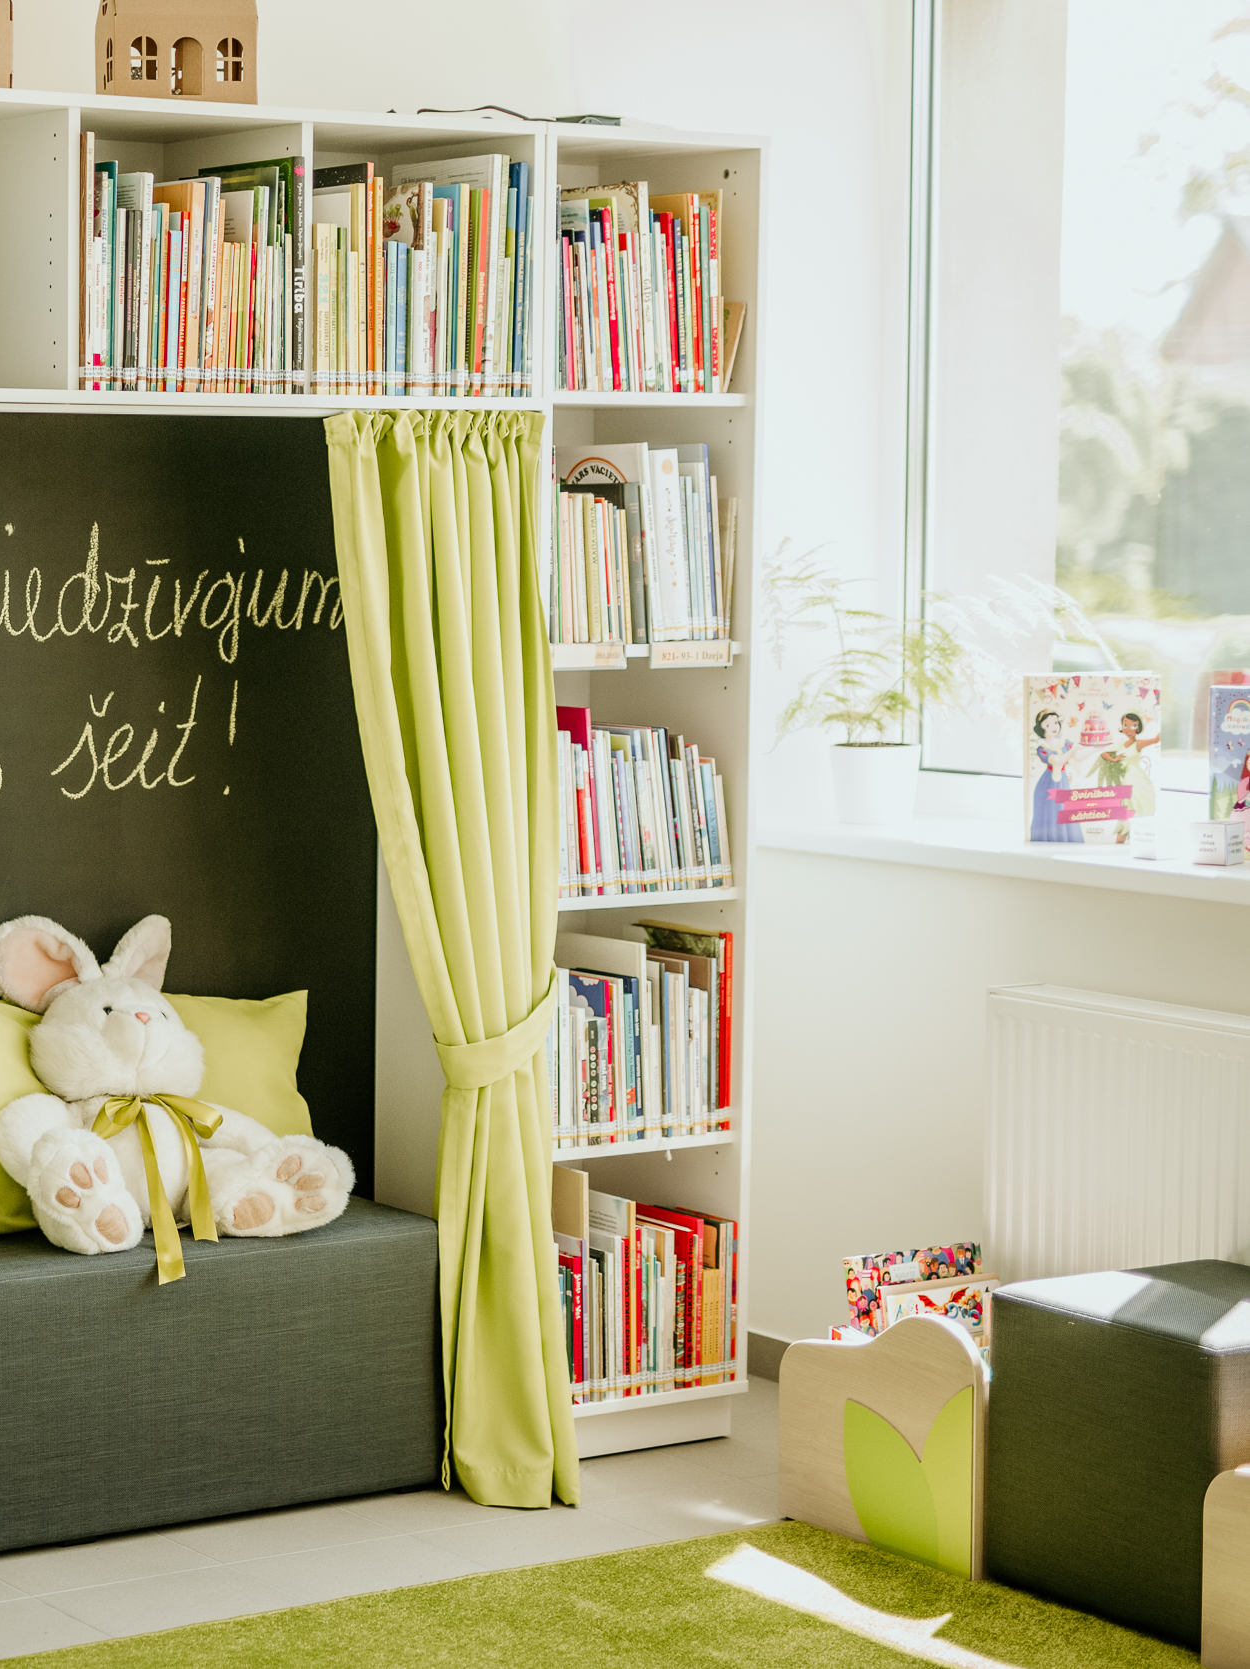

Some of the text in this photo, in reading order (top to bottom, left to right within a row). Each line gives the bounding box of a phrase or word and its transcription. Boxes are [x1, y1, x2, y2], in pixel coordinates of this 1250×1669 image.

[318, 273, 329, 305] 321
[643, 278, 652, 303] GADS
[702, 651, 724, 662] Dzeja
[51, 674, 238, 800] šeit!
[1070, 789, 1116, 802] Svinības
